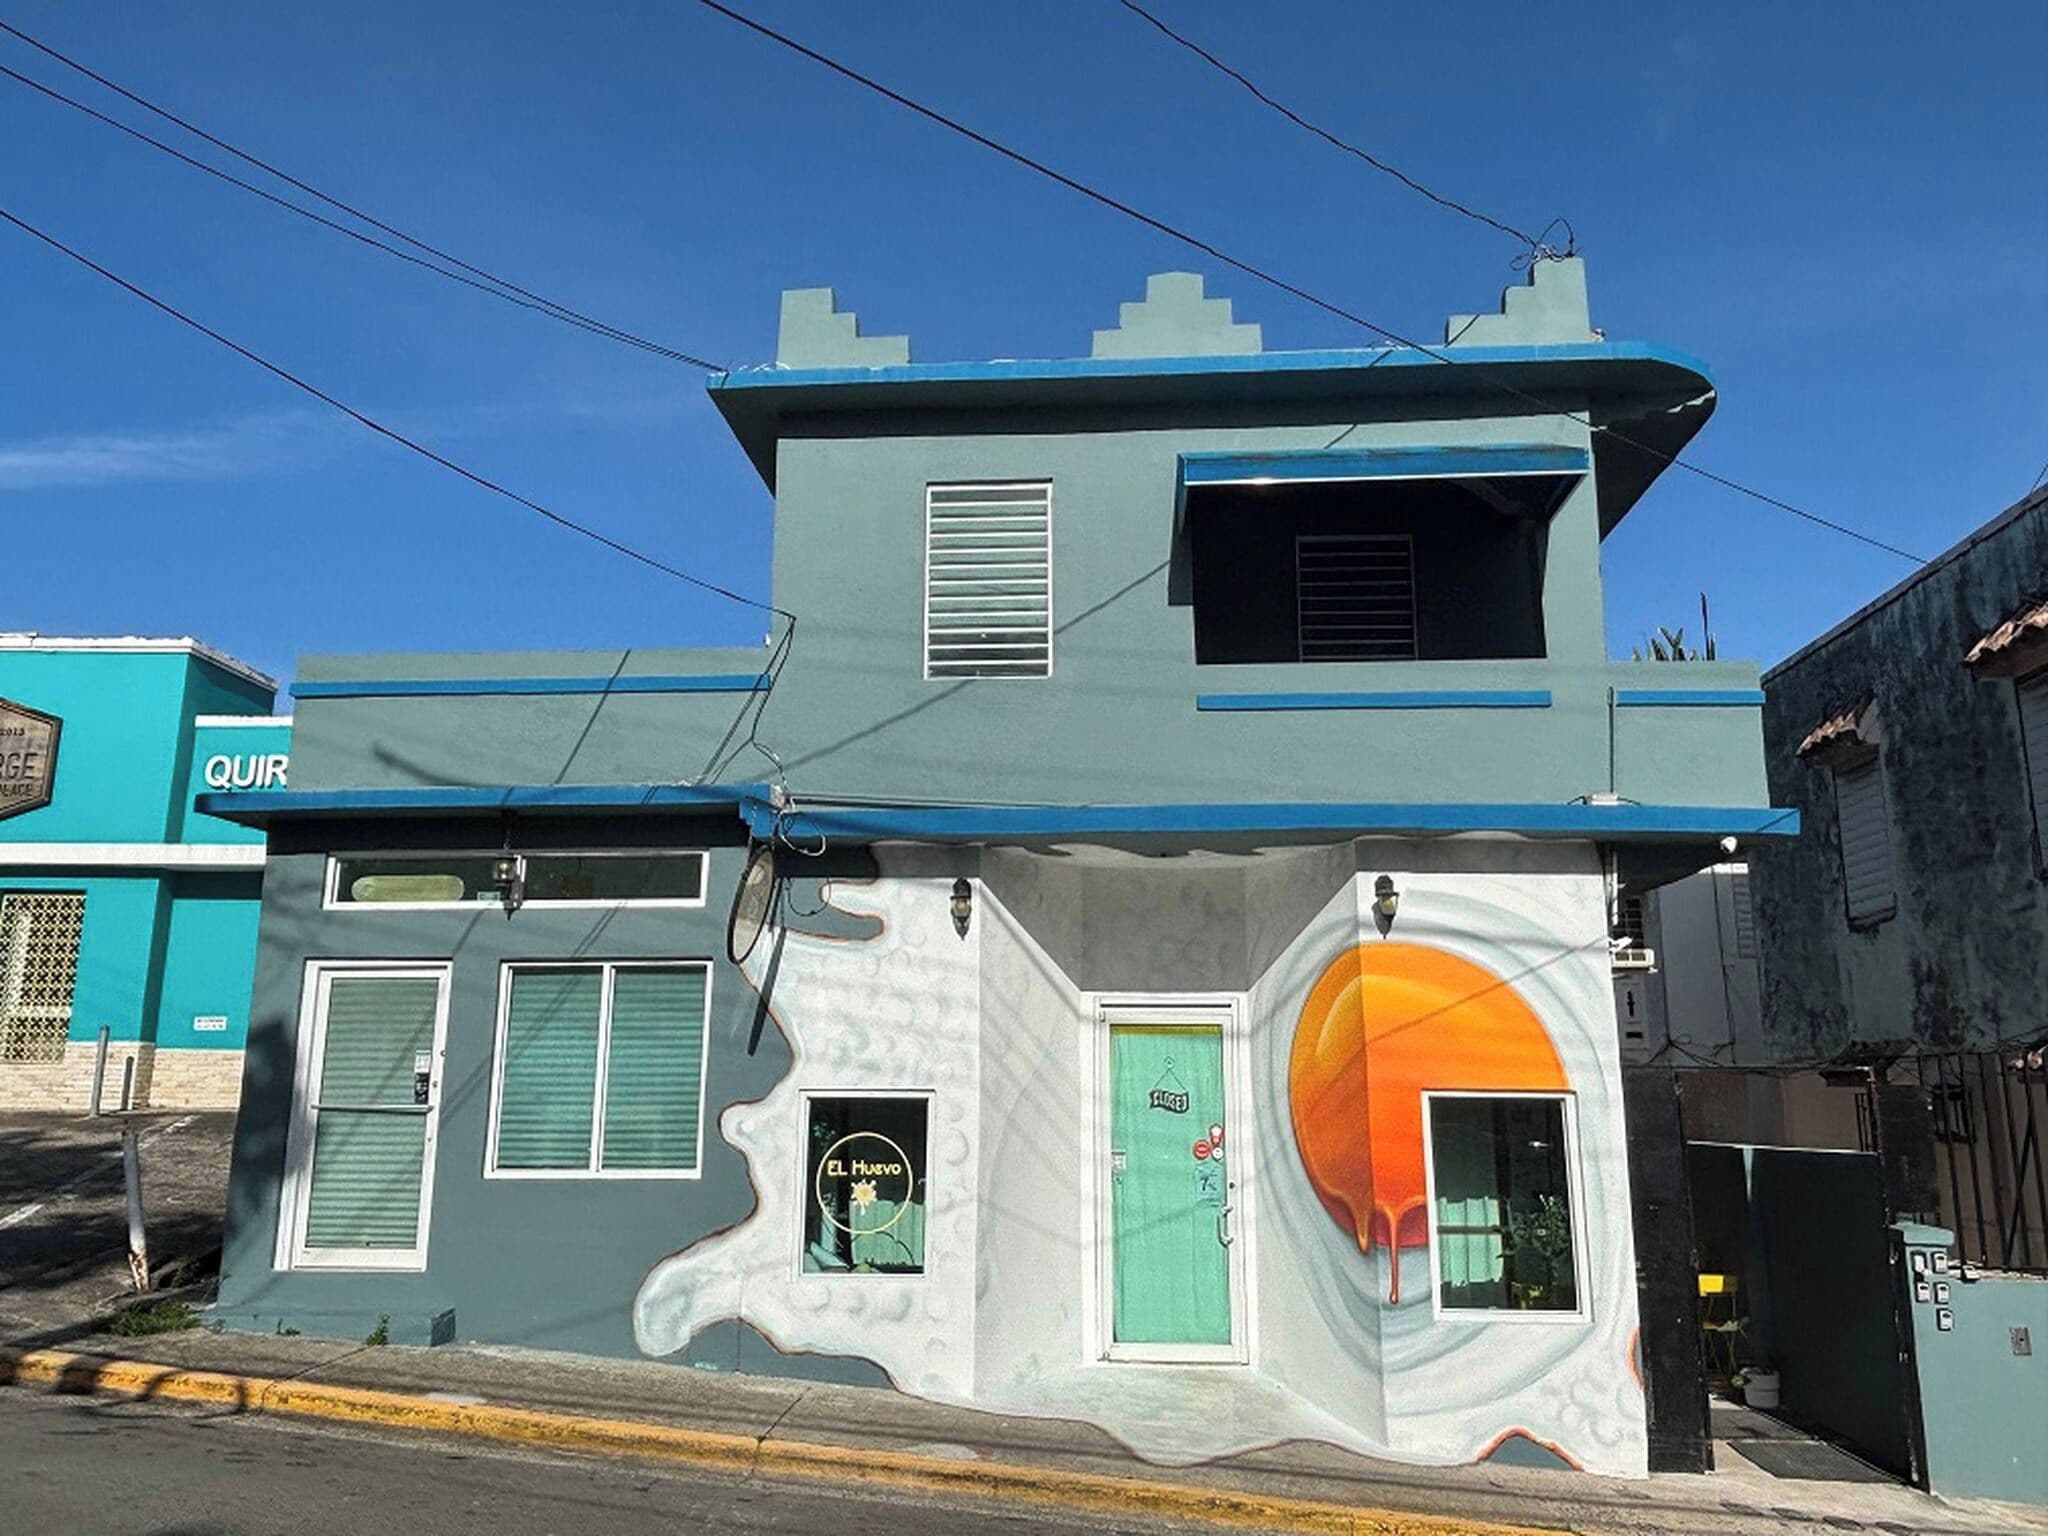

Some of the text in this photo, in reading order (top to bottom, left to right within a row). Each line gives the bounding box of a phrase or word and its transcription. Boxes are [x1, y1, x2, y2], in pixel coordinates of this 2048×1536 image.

[205, 754, 289, 789] QUIR
[0, 783, 34, 797] LACE
[852, 1159, 902, 1176] Huevo
